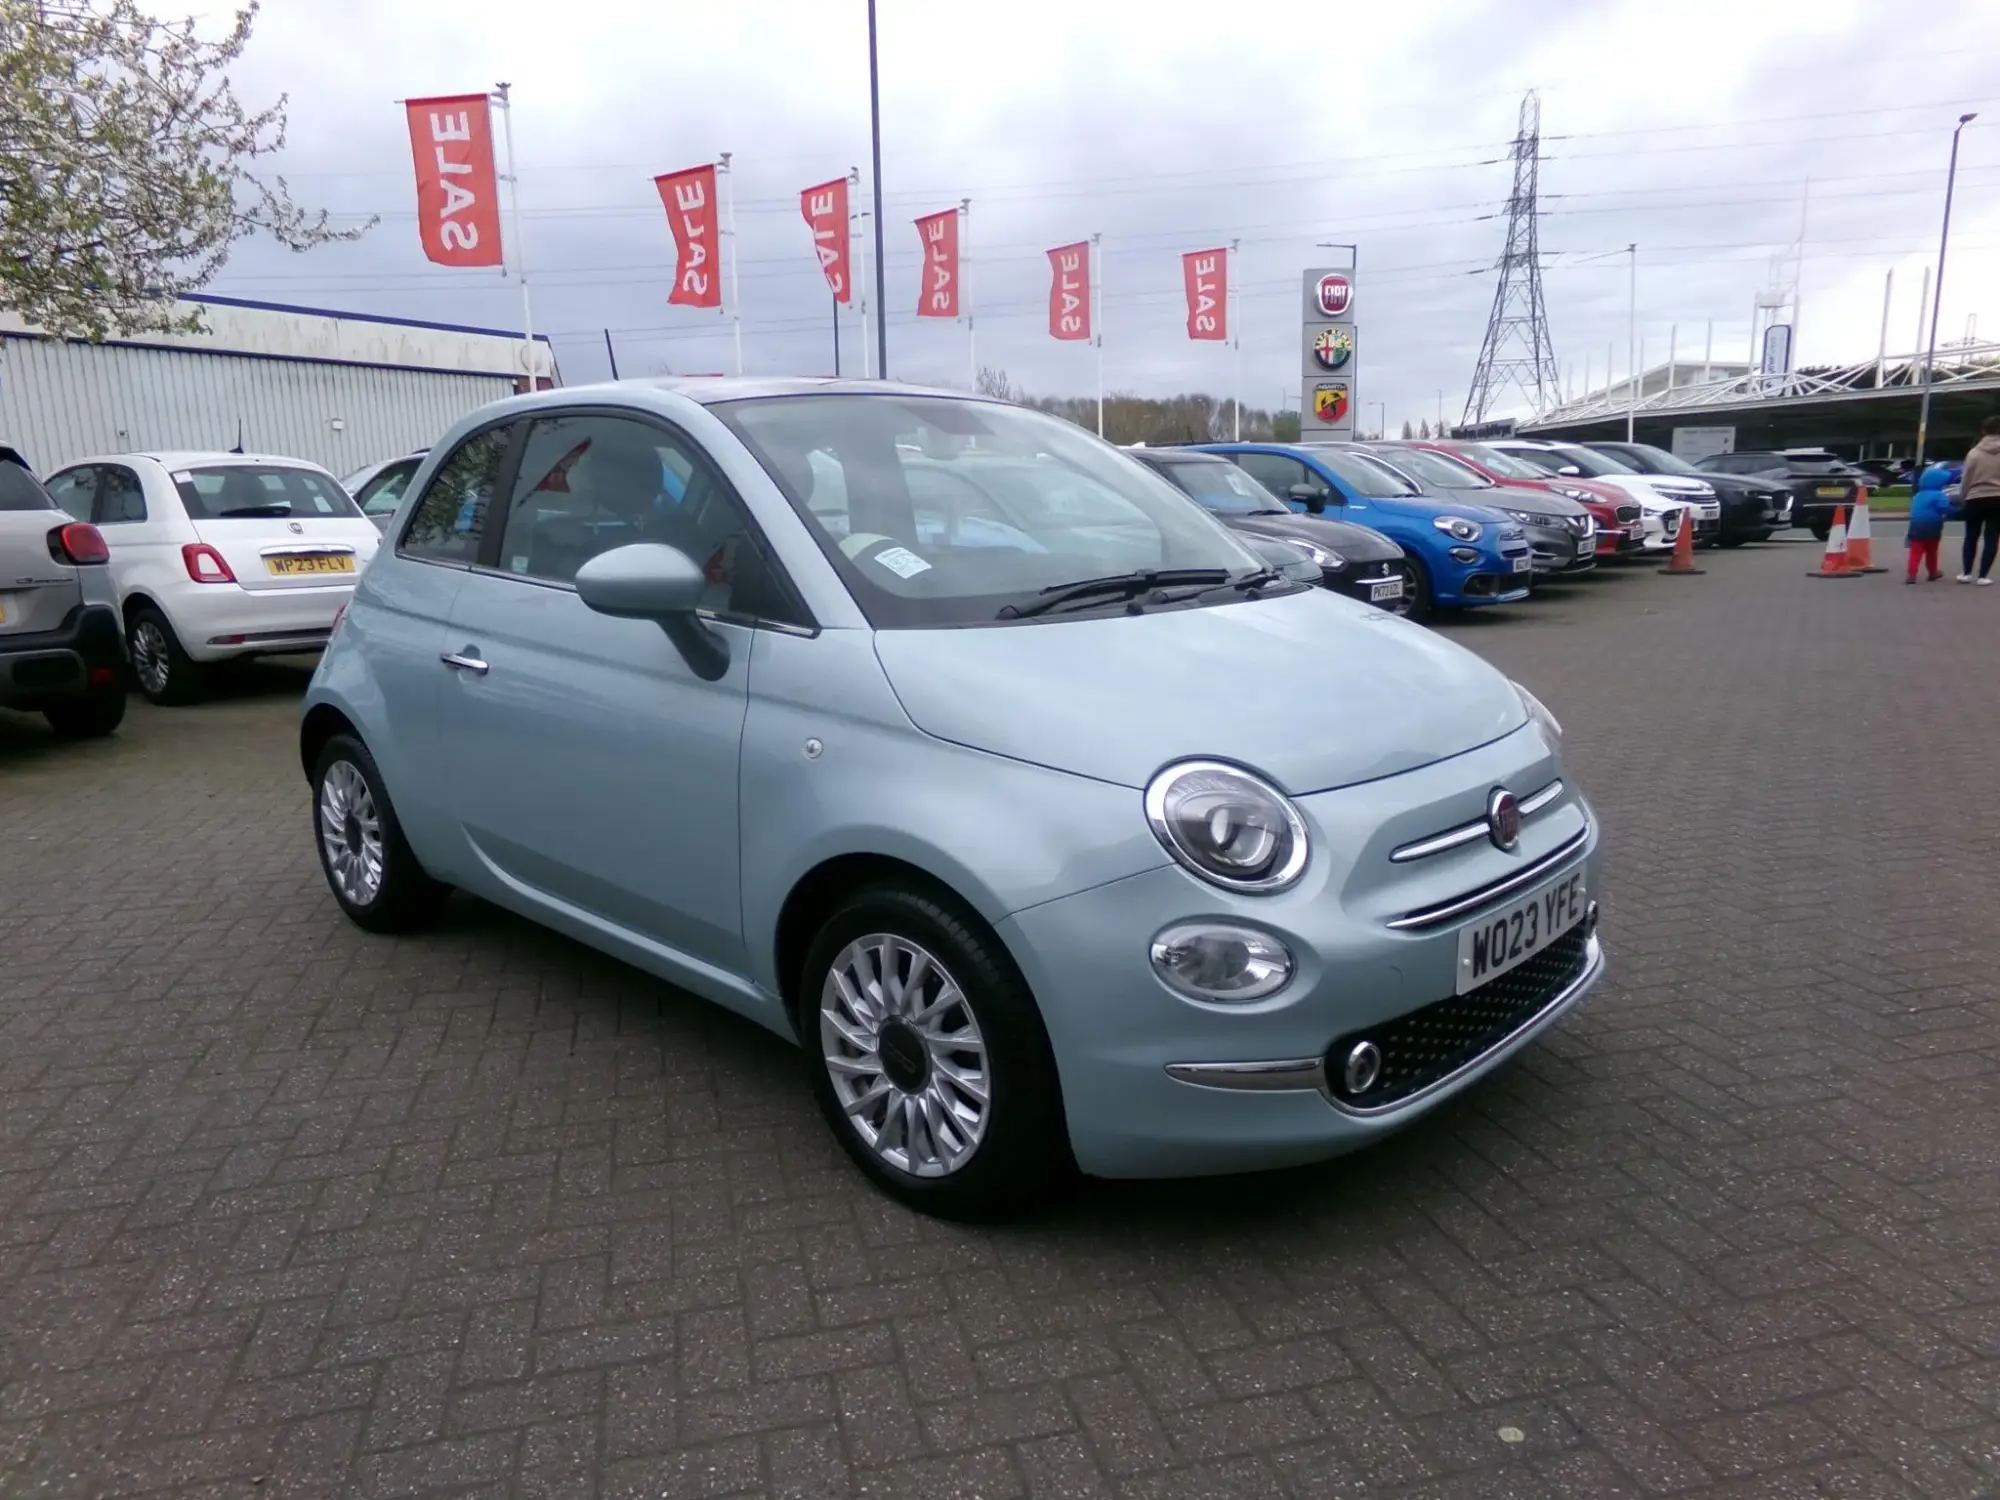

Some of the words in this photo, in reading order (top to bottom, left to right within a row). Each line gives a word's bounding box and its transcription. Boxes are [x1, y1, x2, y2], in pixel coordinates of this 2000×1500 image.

[1324, 285, 1347, 304] FIAT
[272, 557, 315, 573] WP23
[1544, 872, 1581, 936] YFE
